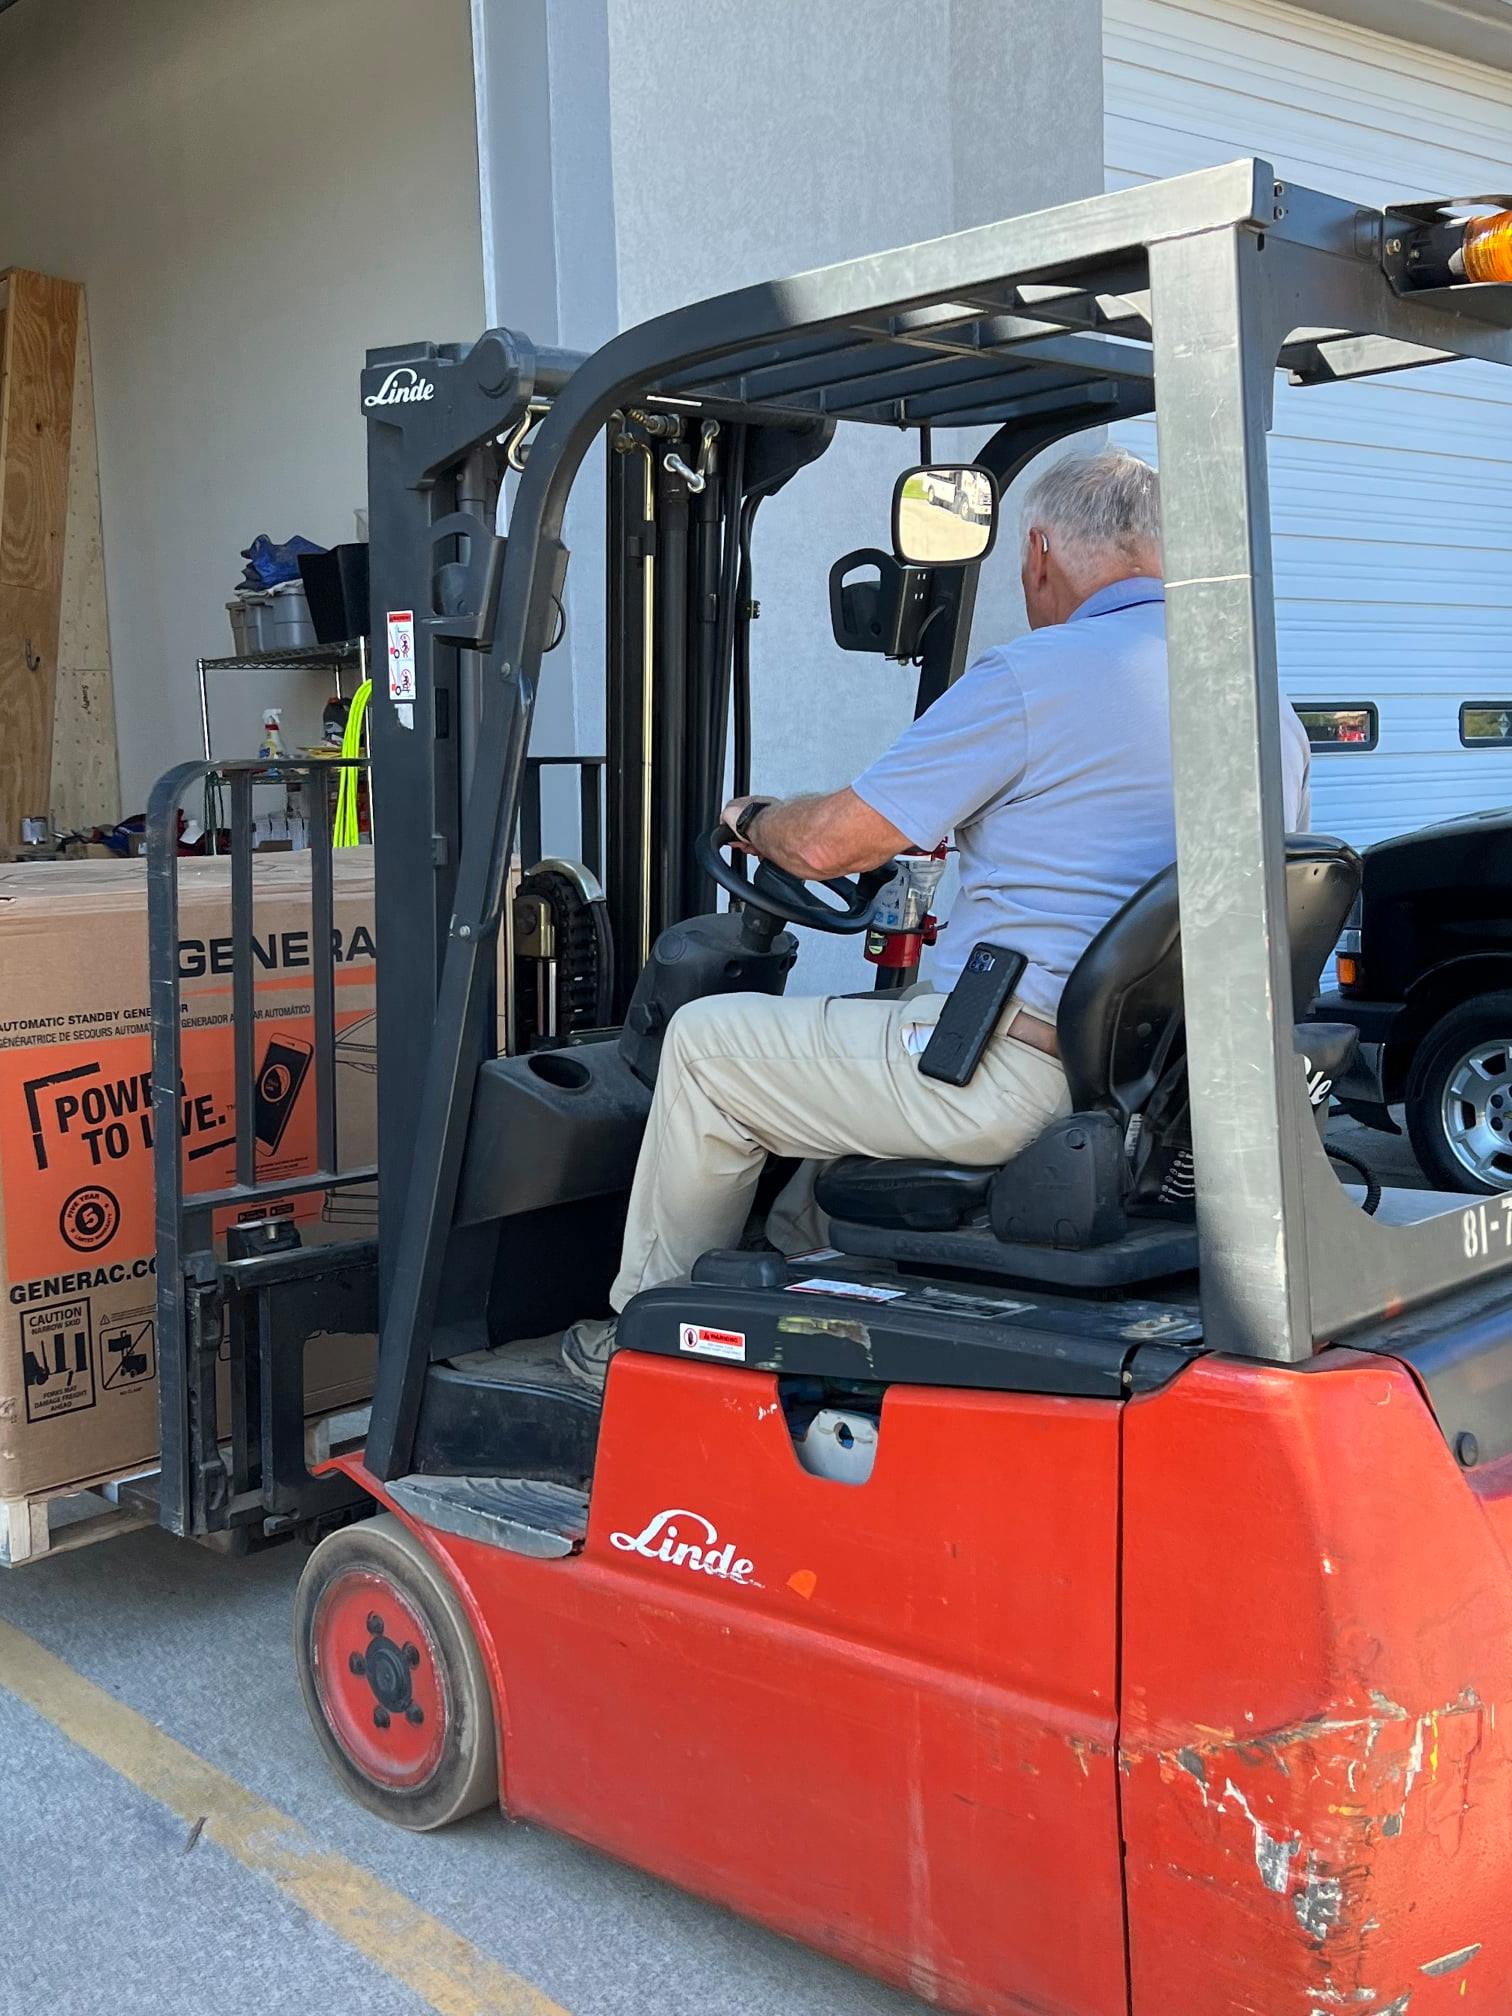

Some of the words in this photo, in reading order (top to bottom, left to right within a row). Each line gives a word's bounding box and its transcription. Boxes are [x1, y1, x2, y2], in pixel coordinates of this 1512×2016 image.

[364, 368, 434, 406] Linde
[68, 1010, 120, 1025] STANDBY
[181, 1014, 229, 1028] GENERADOR
[264, 1004, 311, 1019] AUTOMÁTICO
[59, 1031, 71, 1042] DE
[73, 1026, 113, 1041] SECOURS
[81, 1122, 129, 1165] TO
[79, 1193, 100, 1202] YEAR
[82, 1207, 99, 1228] 5
[10, 1257, 157, 1304] GENERAC.CO
[30, 1306, 82, 1327] CAUTION
[609, 1509, 754, 1585] Linde
